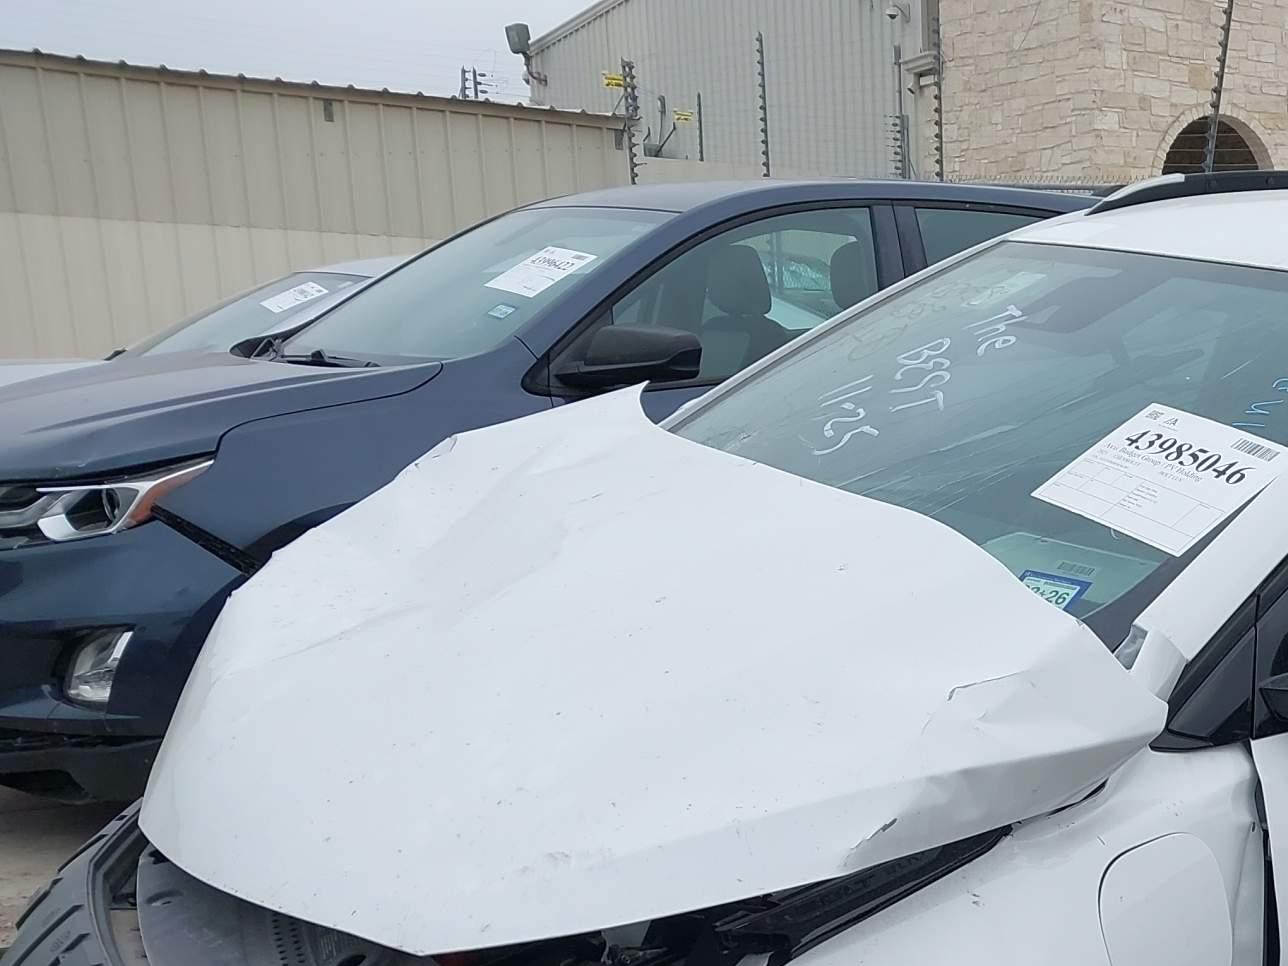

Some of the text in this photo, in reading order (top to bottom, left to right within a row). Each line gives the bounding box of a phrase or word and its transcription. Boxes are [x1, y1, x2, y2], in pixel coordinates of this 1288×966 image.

[963, 305, 1028, 357] The
[1125, 430, 1256, 485] 43985046
[1045, 590, 1070, 605] 26
